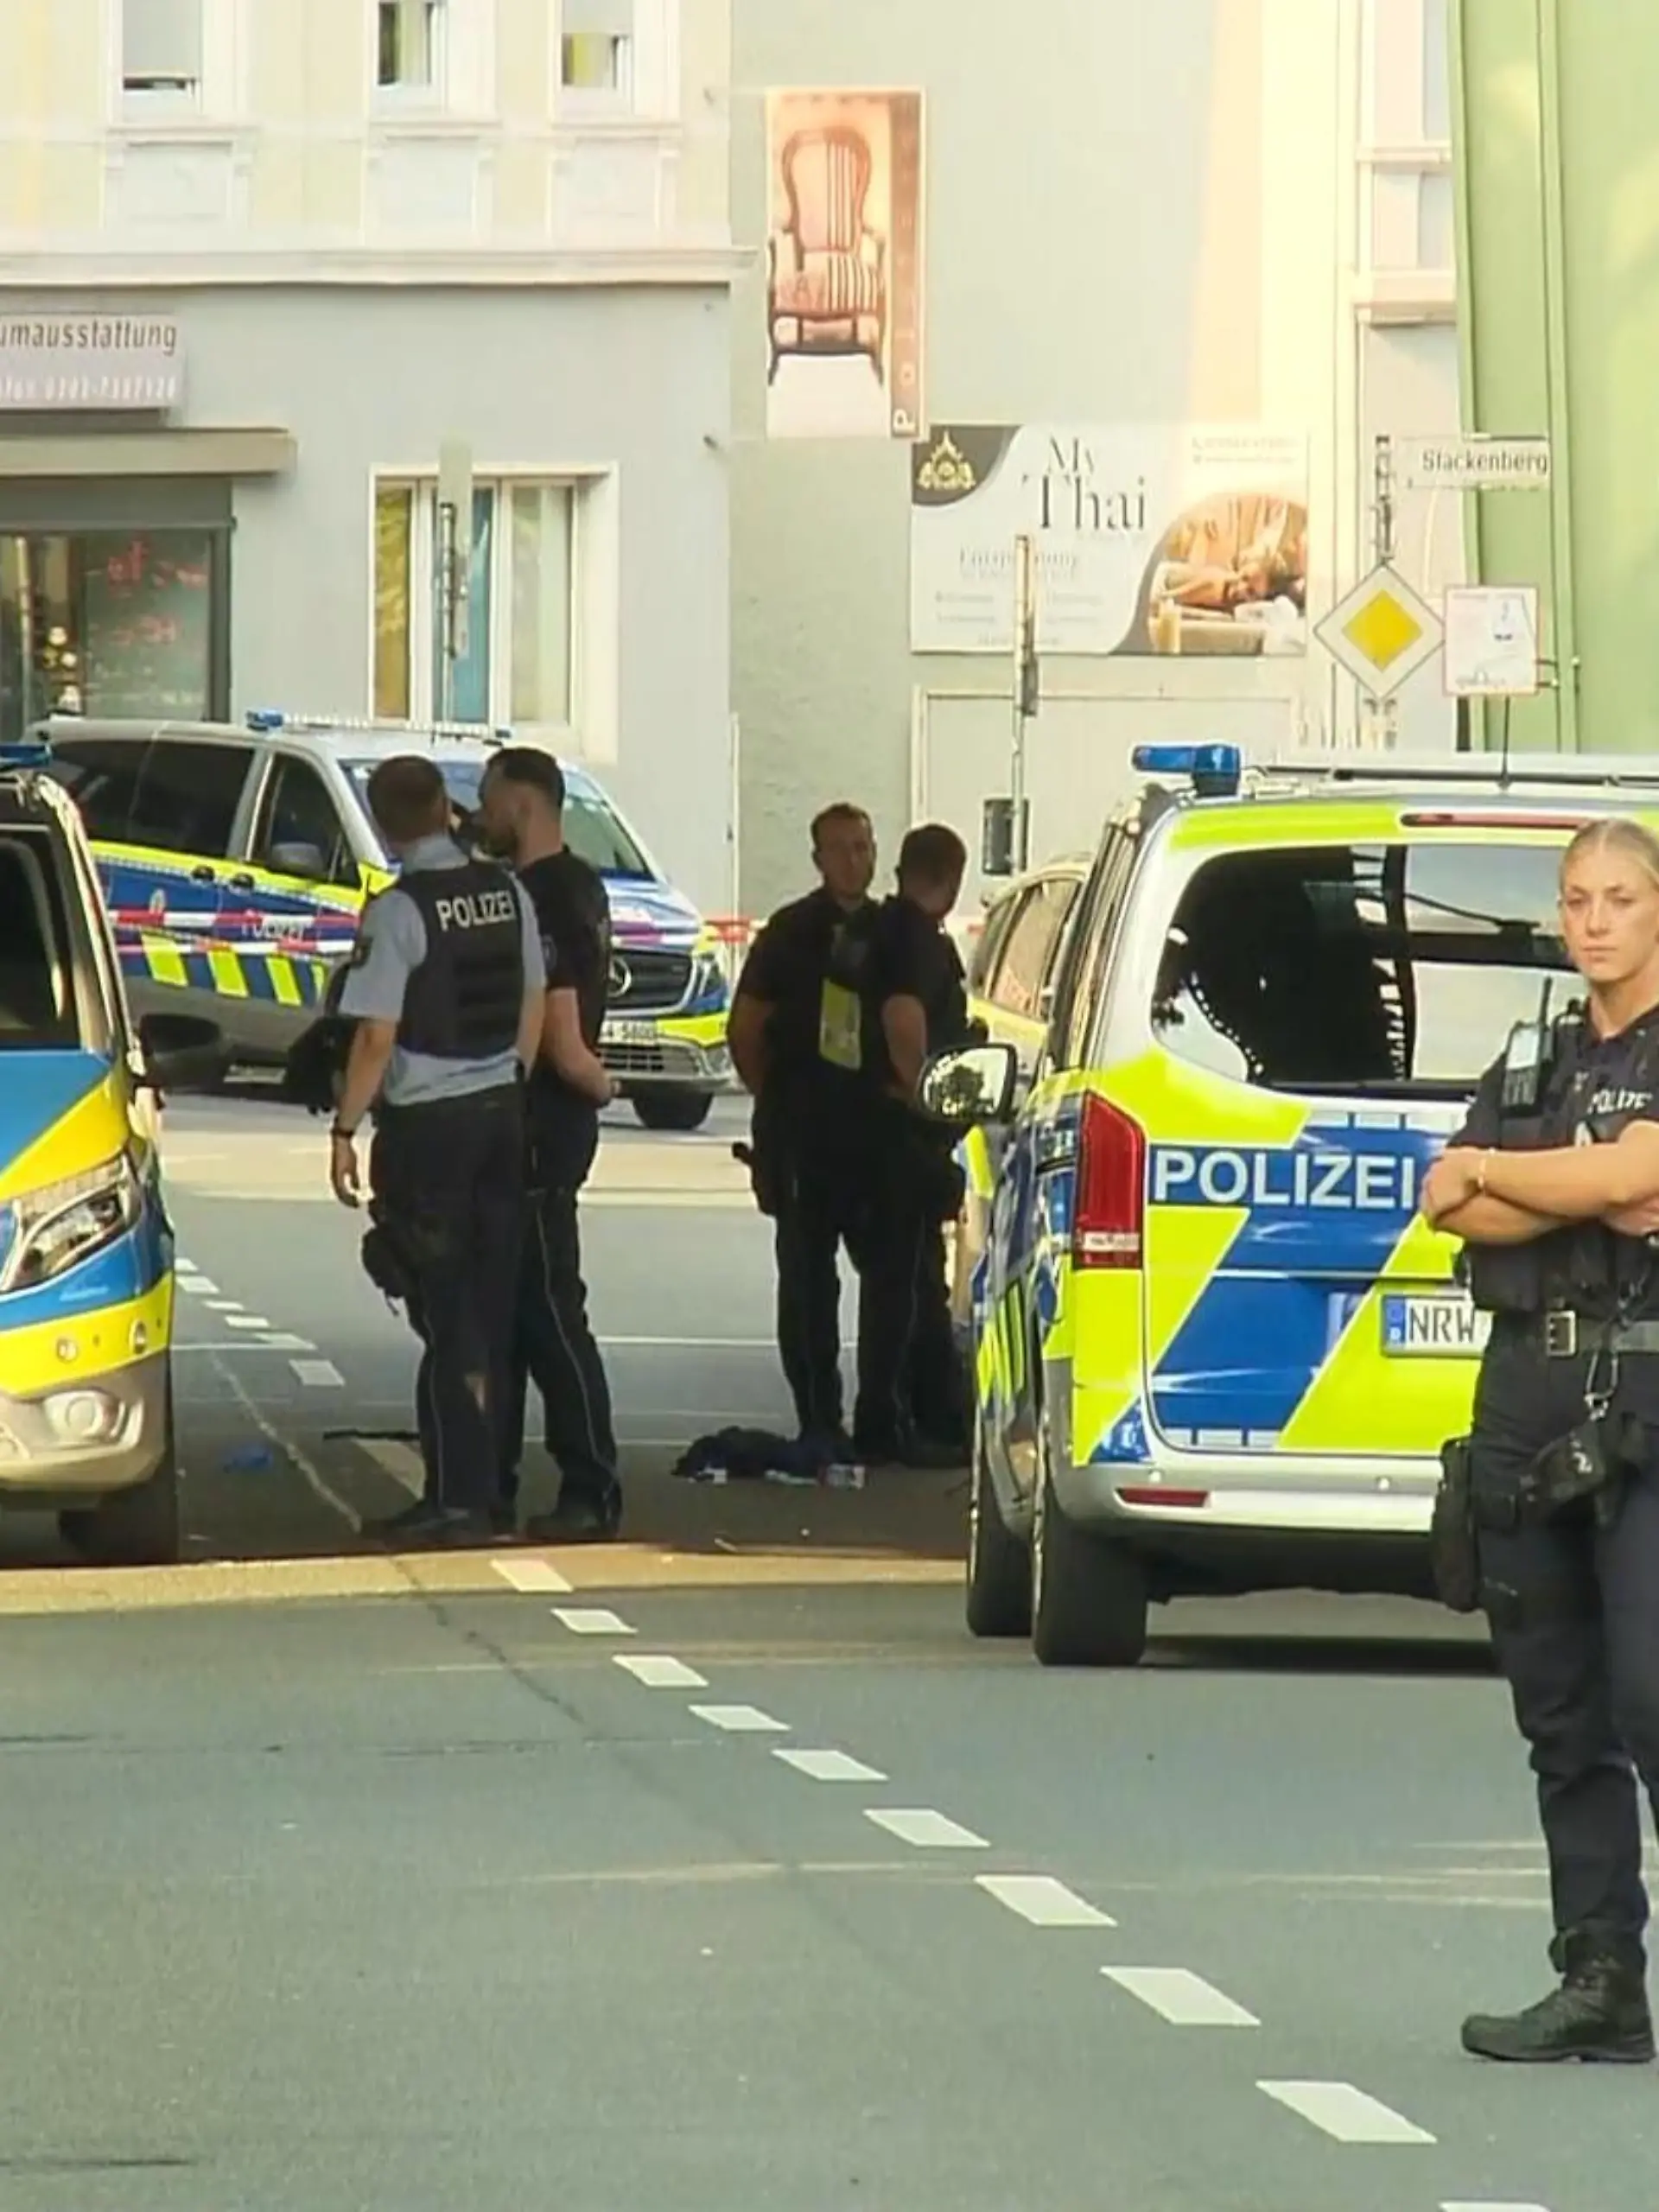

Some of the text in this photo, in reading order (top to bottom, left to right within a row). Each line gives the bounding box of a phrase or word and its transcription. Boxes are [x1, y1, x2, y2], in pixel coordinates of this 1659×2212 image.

[1047, 435, 1095, 474] My
[1423, 449, 1547, 476] Stackenberg
[1022, 474, 1145, 530] Thai
[435, 890, 517, 931] POLIZEI
[1154, 1149, 1415, 1209] POLIZEI
[1409, 1306, 1475, 1343] NRW
